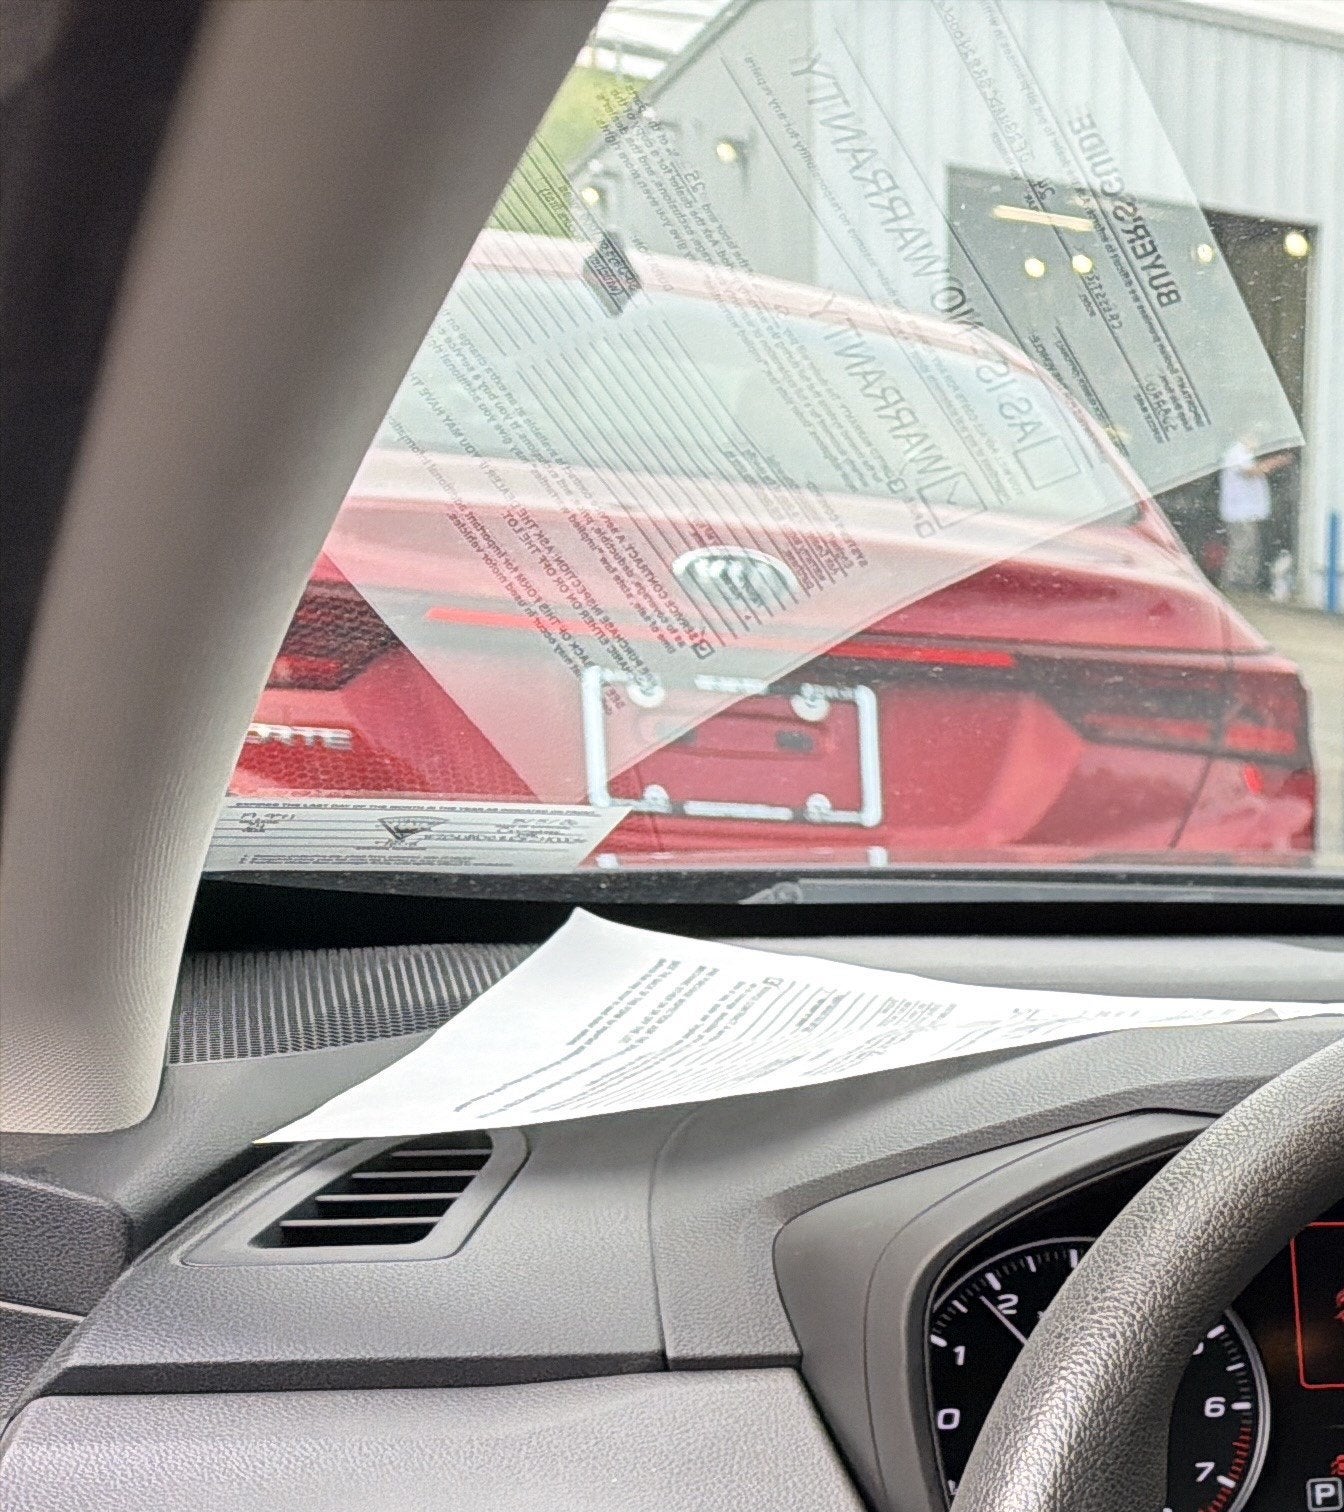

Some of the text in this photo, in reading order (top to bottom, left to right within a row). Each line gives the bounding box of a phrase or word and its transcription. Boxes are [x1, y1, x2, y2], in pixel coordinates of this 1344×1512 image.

[997, 1294, 1019, 1315] 2
[952, 1346, 966, 1366] 1
[1204, 1396, 1227, 1418] 6
[936, 1408, 961, 1430] 0
[1194, 1461, 1215, 1483] 7
[1315, 1484, 1335, 1505] P
